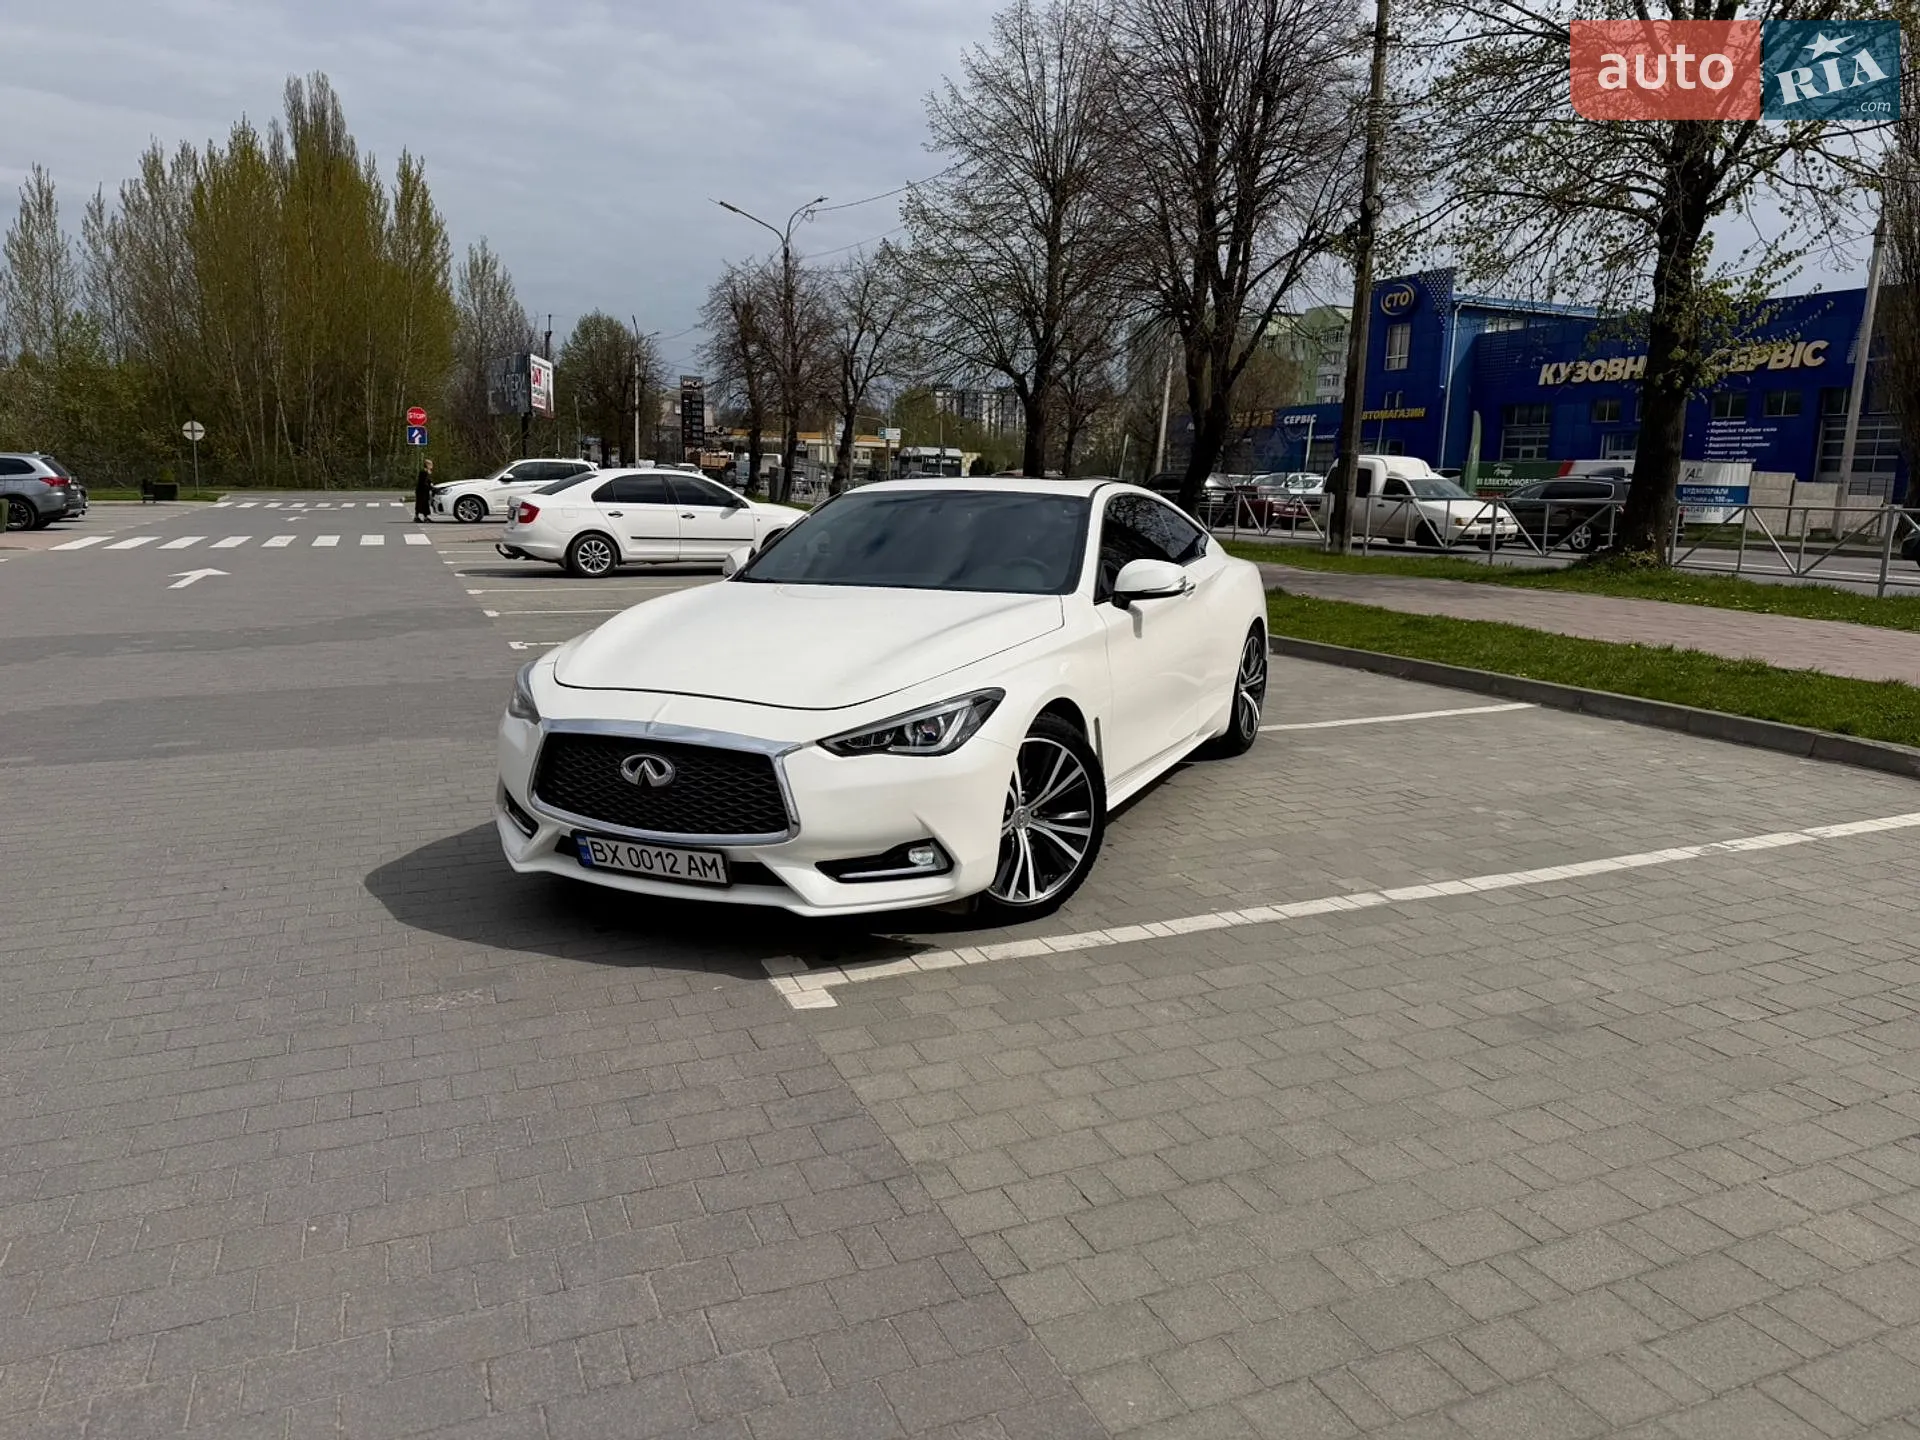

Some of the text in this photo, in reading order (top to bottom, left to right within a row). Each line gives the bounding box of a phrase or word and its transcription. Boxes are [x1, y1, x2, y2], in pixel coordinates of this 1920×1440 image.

[1385, 291, 1410, 308] СТО
[1538, 355, 1648, 386] КУЗОВН
[1362, 407, 1426, 421] ВТОМАГАЗИН
[590, 841, 720, 879] BX 0012 AM
